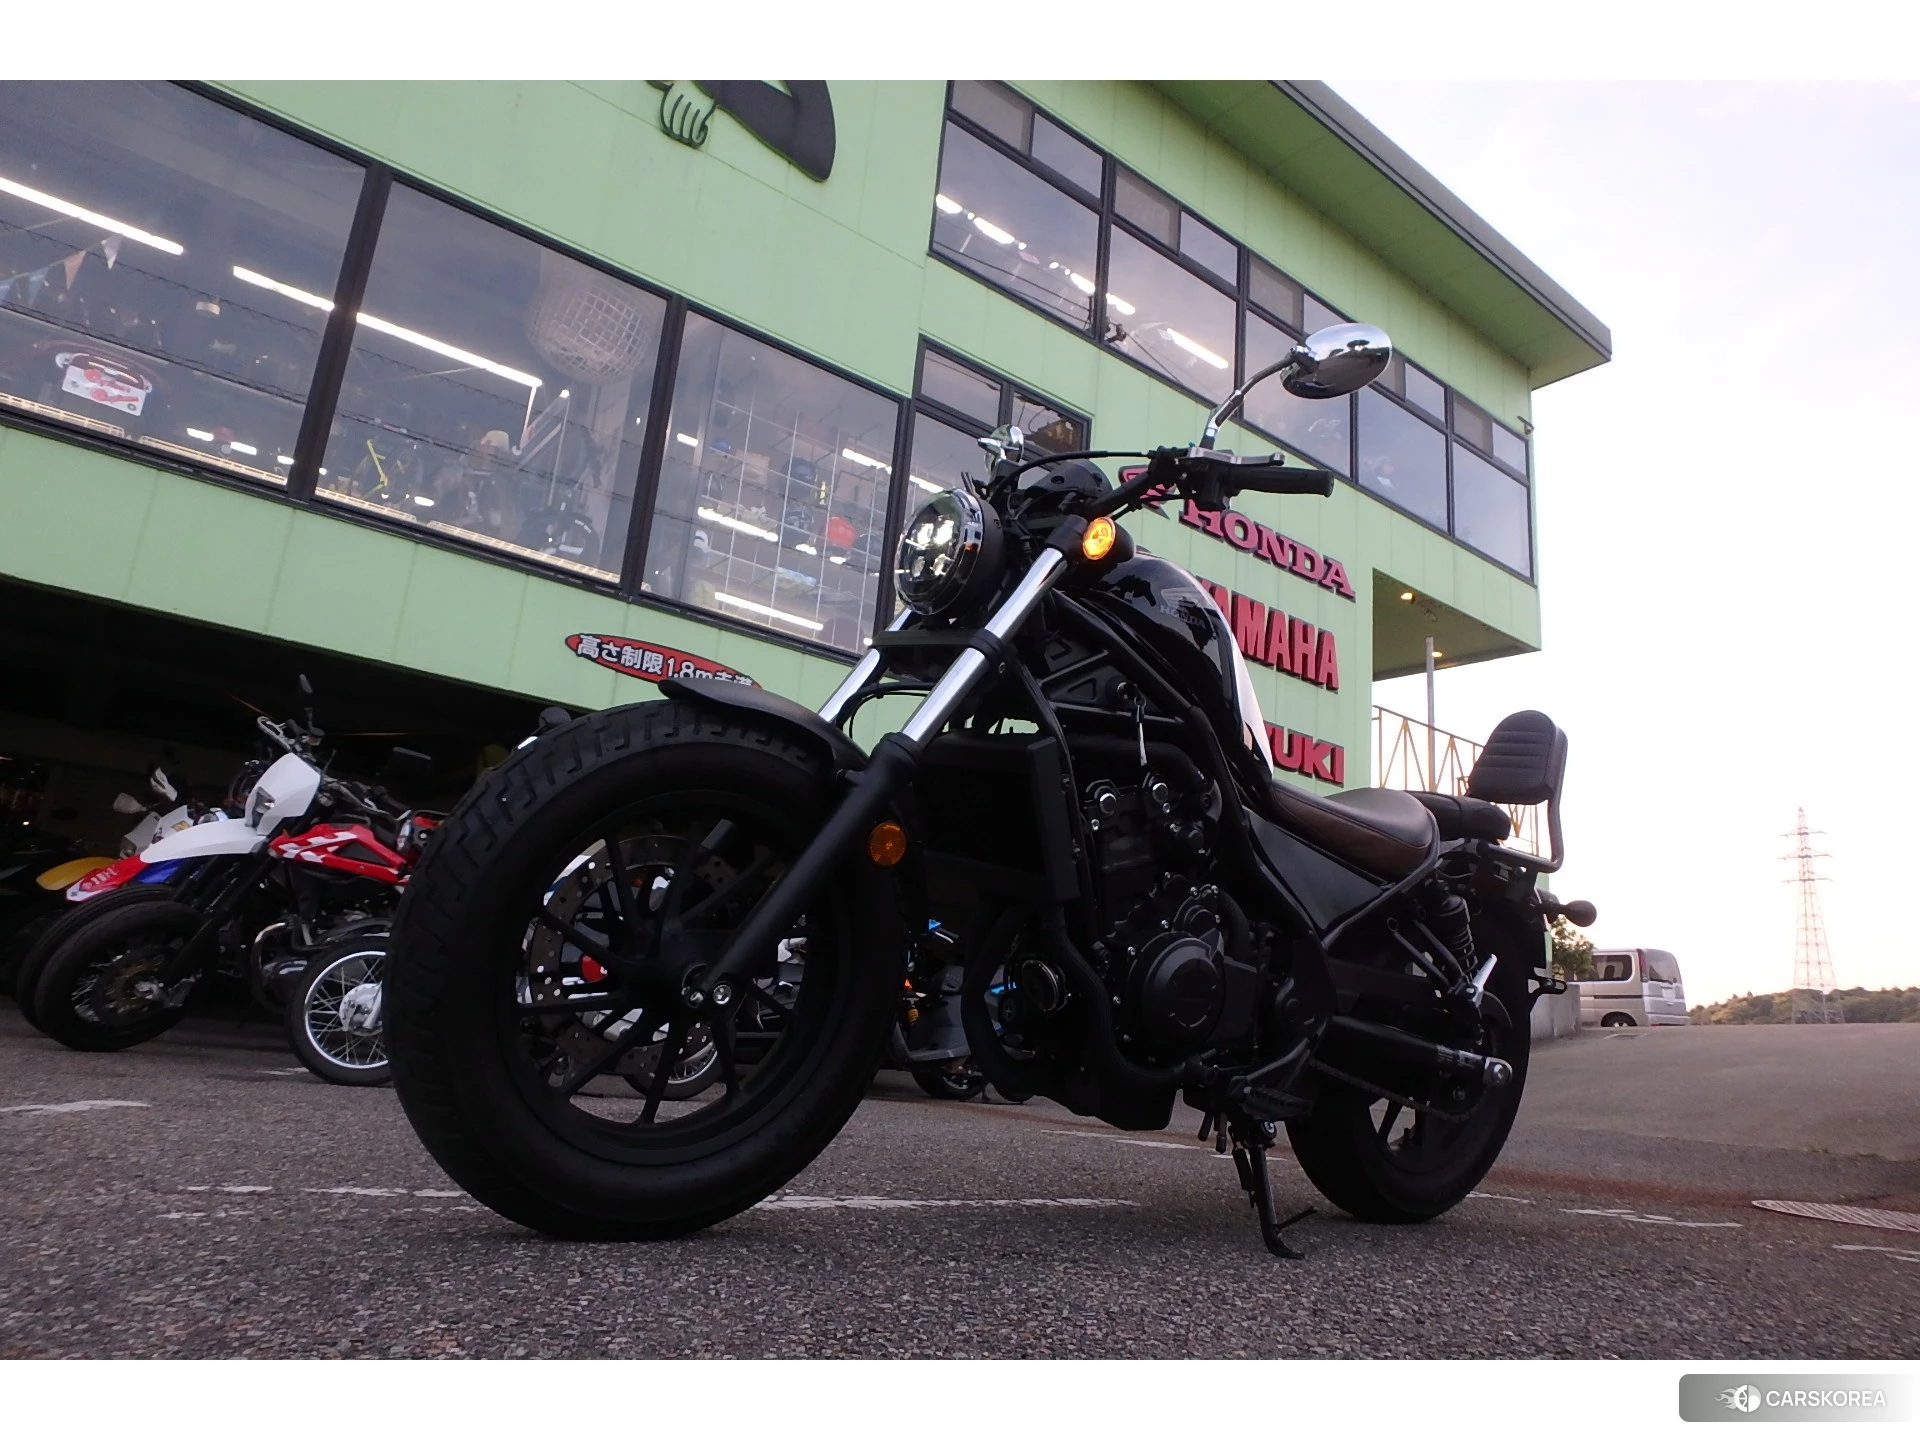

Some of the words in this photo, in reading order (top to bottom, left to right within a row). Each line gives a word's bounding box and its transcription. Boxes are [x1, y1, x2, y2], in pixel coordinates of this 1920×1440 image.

[1182, 499, 1355, 599] HONDA
[1159, 604, 1206, 629] HONDA
[1264, 722, 1344, 783] UKI
